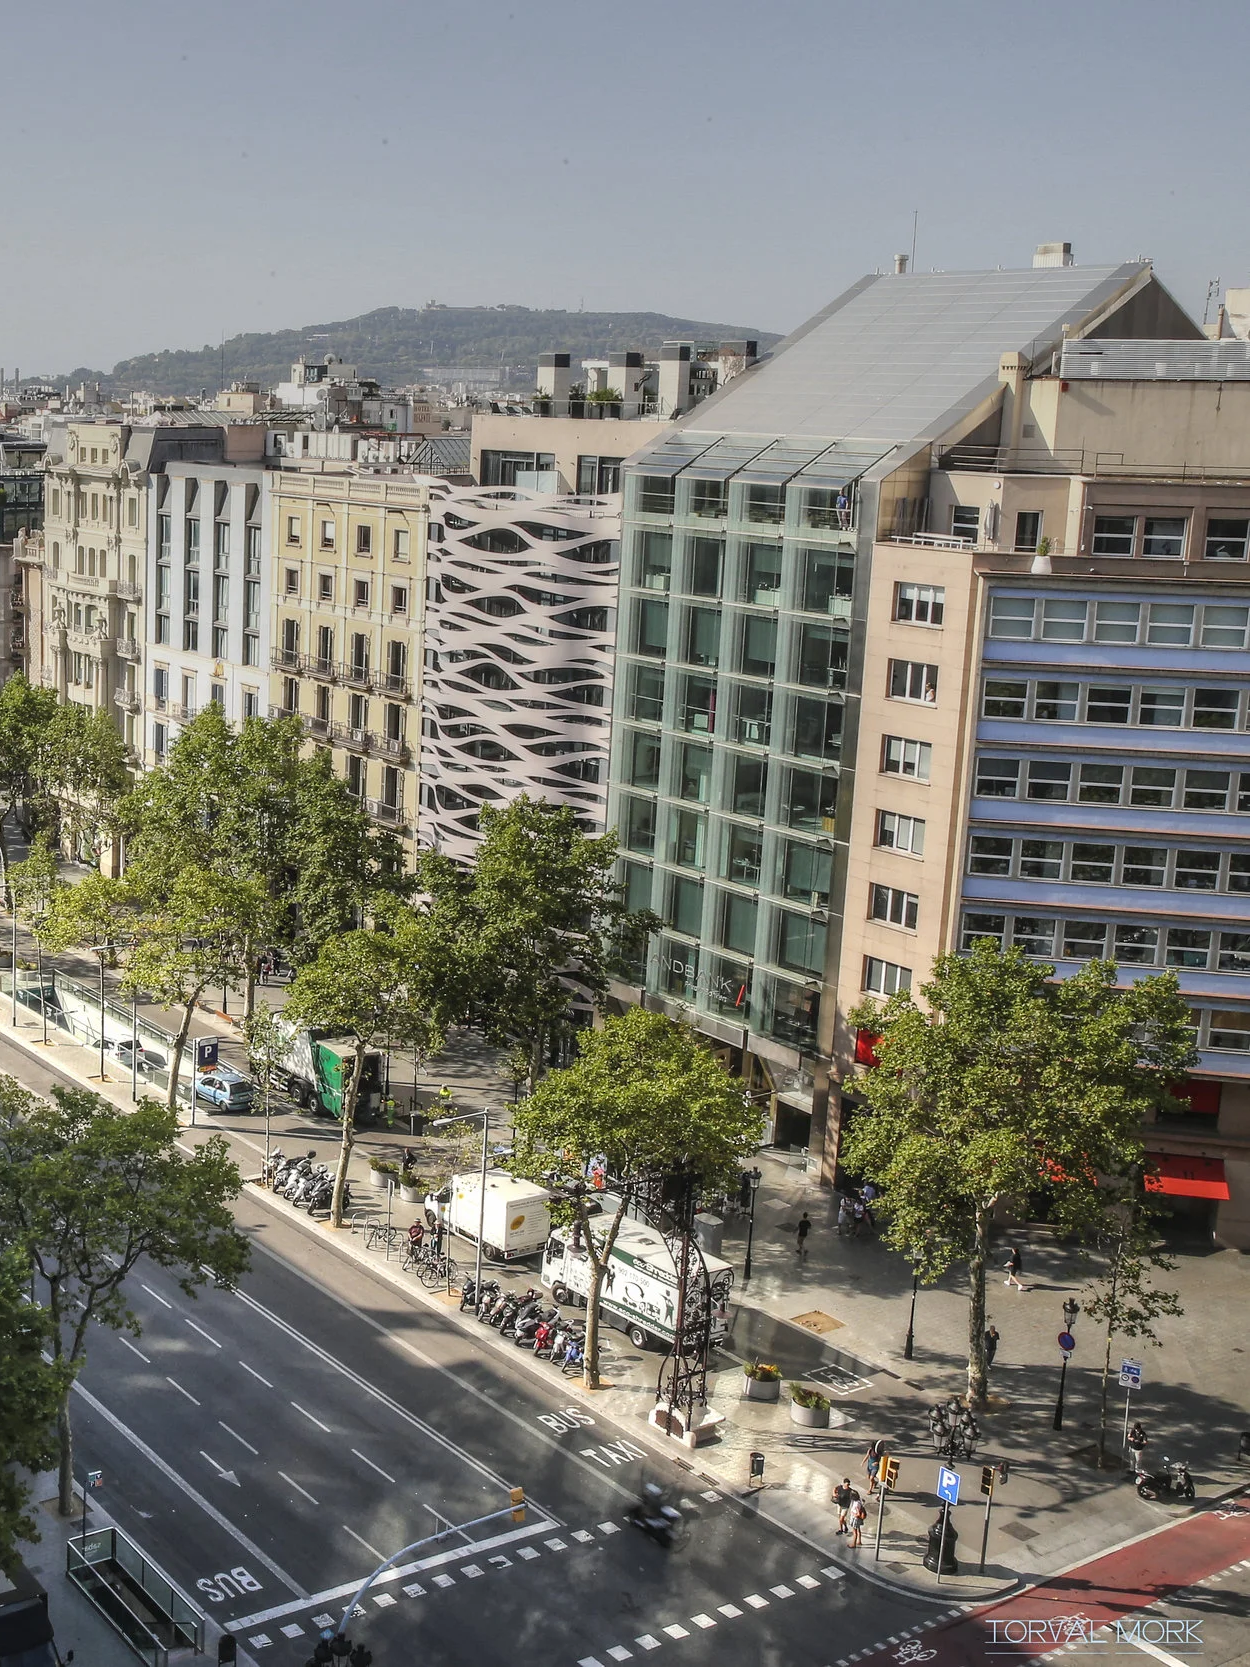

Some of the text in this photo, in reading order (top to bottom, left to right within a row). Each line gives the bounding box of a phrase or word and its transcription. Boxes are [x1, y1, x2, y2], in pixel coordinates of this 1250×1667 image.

[650, 953, 733, 993] ANDBANK
[204, 1045, 212, 1058] P
[537, 1407, 596, 1434] BUS
[579, 1439, 649, 1468] TAXI
[942, 1470, 957, 1488] P
[196, 1566, 264, 1602] BUS
